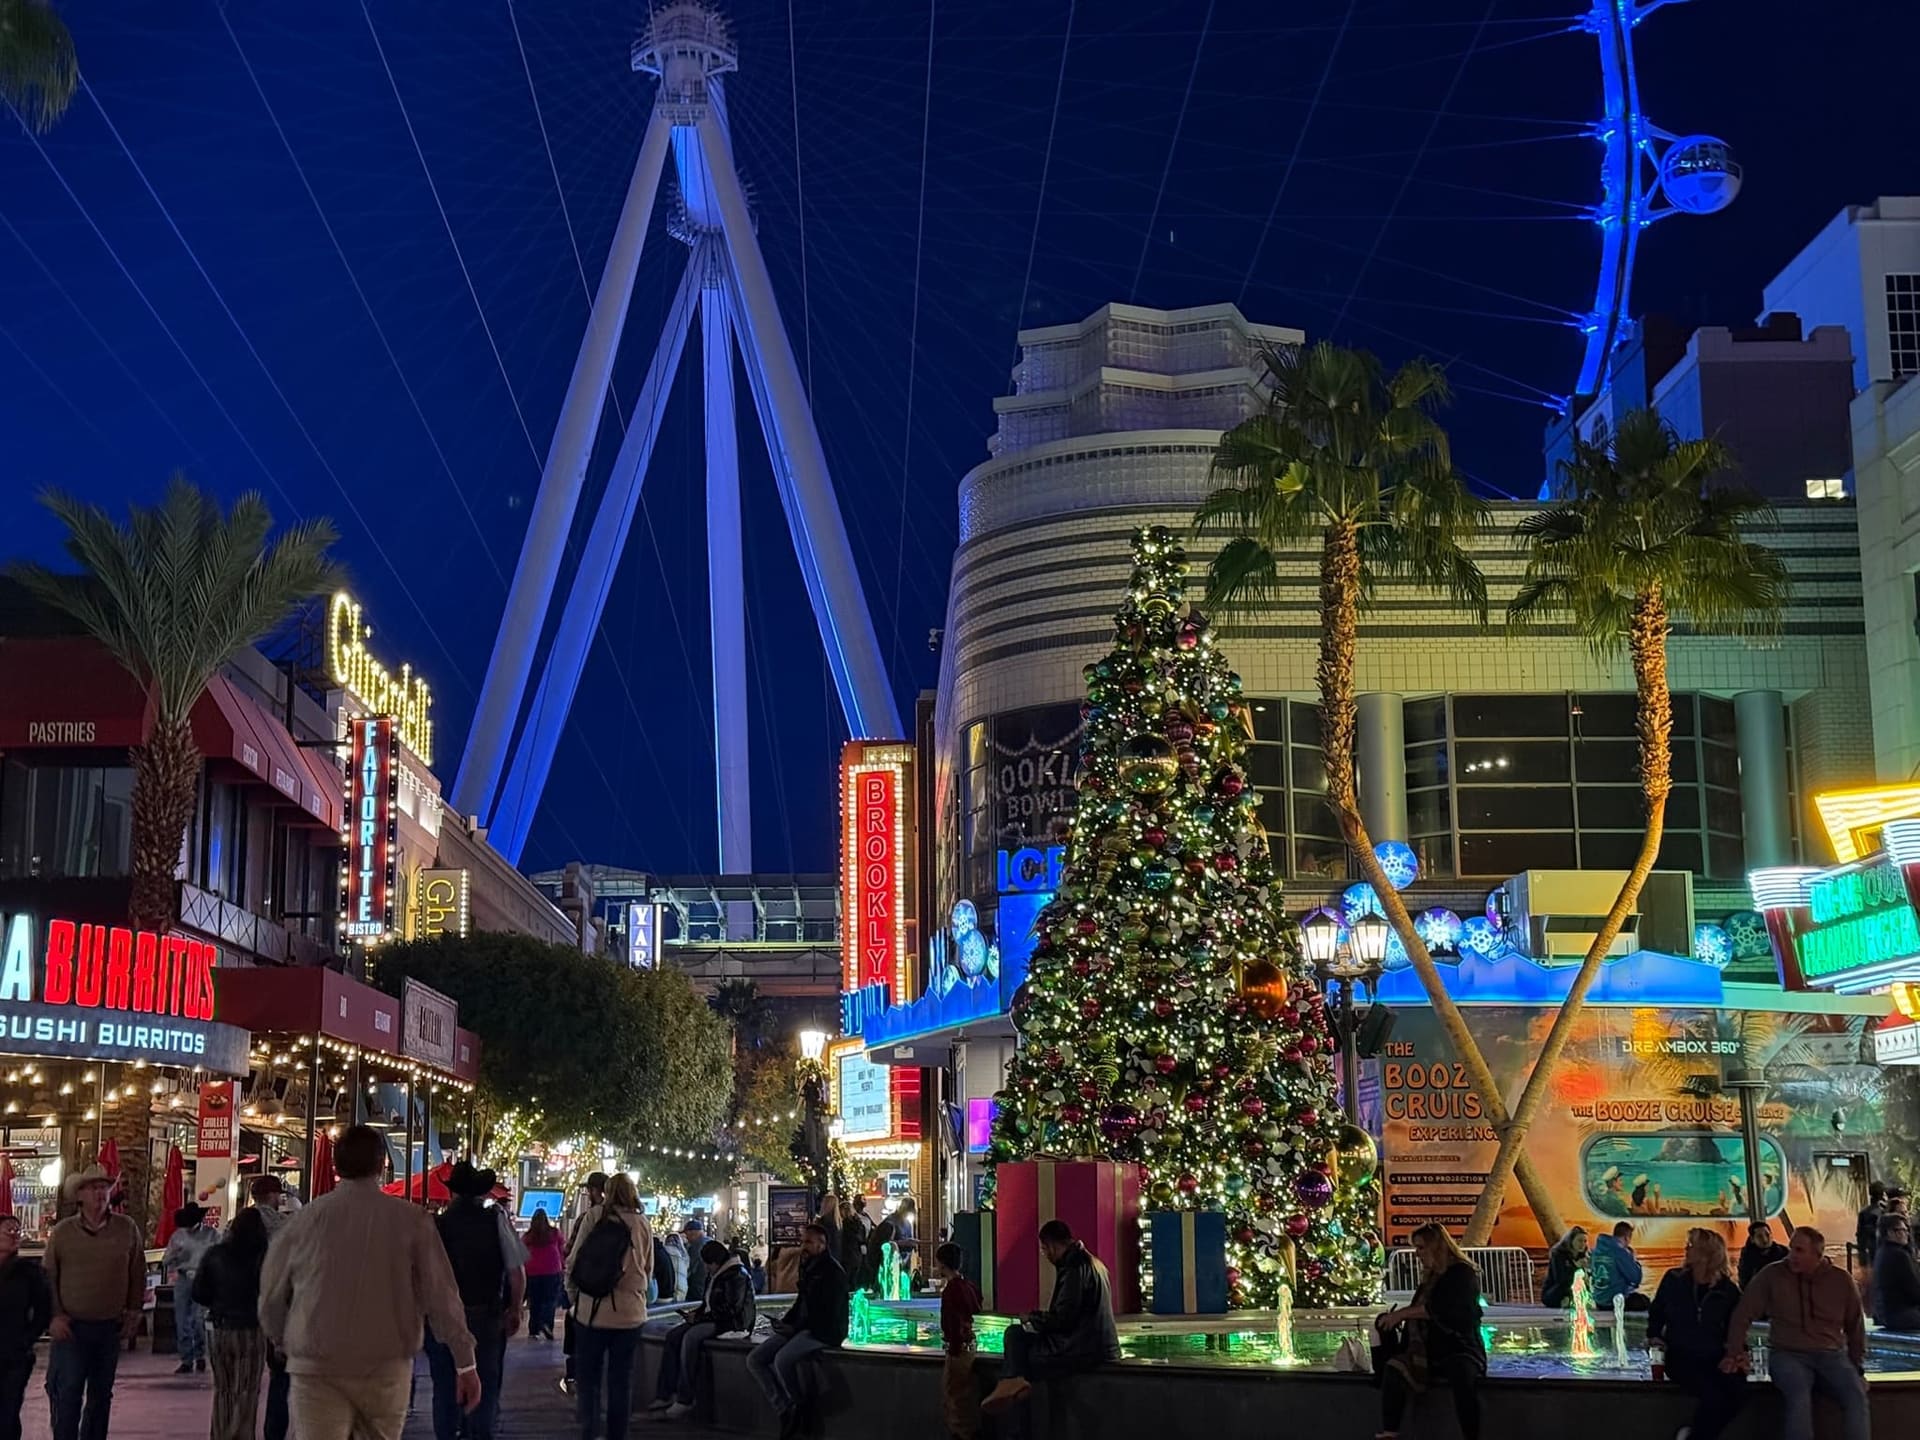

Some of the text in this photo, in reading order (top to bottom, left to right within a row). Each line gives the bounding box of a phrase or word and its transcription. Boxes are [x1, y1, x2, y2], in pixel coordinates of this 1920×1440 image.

[28, 721, 96, 744] PASTRIES
[1001, 754, 1074, 794] OOKL
[1007, 790, 1073, 819] BOWL
[360, 721, 377, 922] FAVORITE
[426, 879, 456, 936] Ghi
[348, 923, 382, 935] BISTRO
[633, 907, 650, 968] YAR
[44, 919, 217, 1021] BURRITOS
[99, 1023, 206, 1055] BURRITOS
[1385, 1042, 1414, 1057] THE
[1622, 1041, 1708, 1053] DREAMBOX
[1385, 1063, 1470, 1089] BOOZ
[1386, 1092, 1488, 1118] CRUIS
[1571, 1106, 1594, 1118] THE
[1595, 1100, 1662, 1122] BOOZE
[1665, 1100, 1736, 1122] CRUISE
[201, 1128, 229, 1139] CHICKEN
[203, 1117, 229, 1128] GRILLED
[200, 1140, 230, 1151] TERIYAKI
